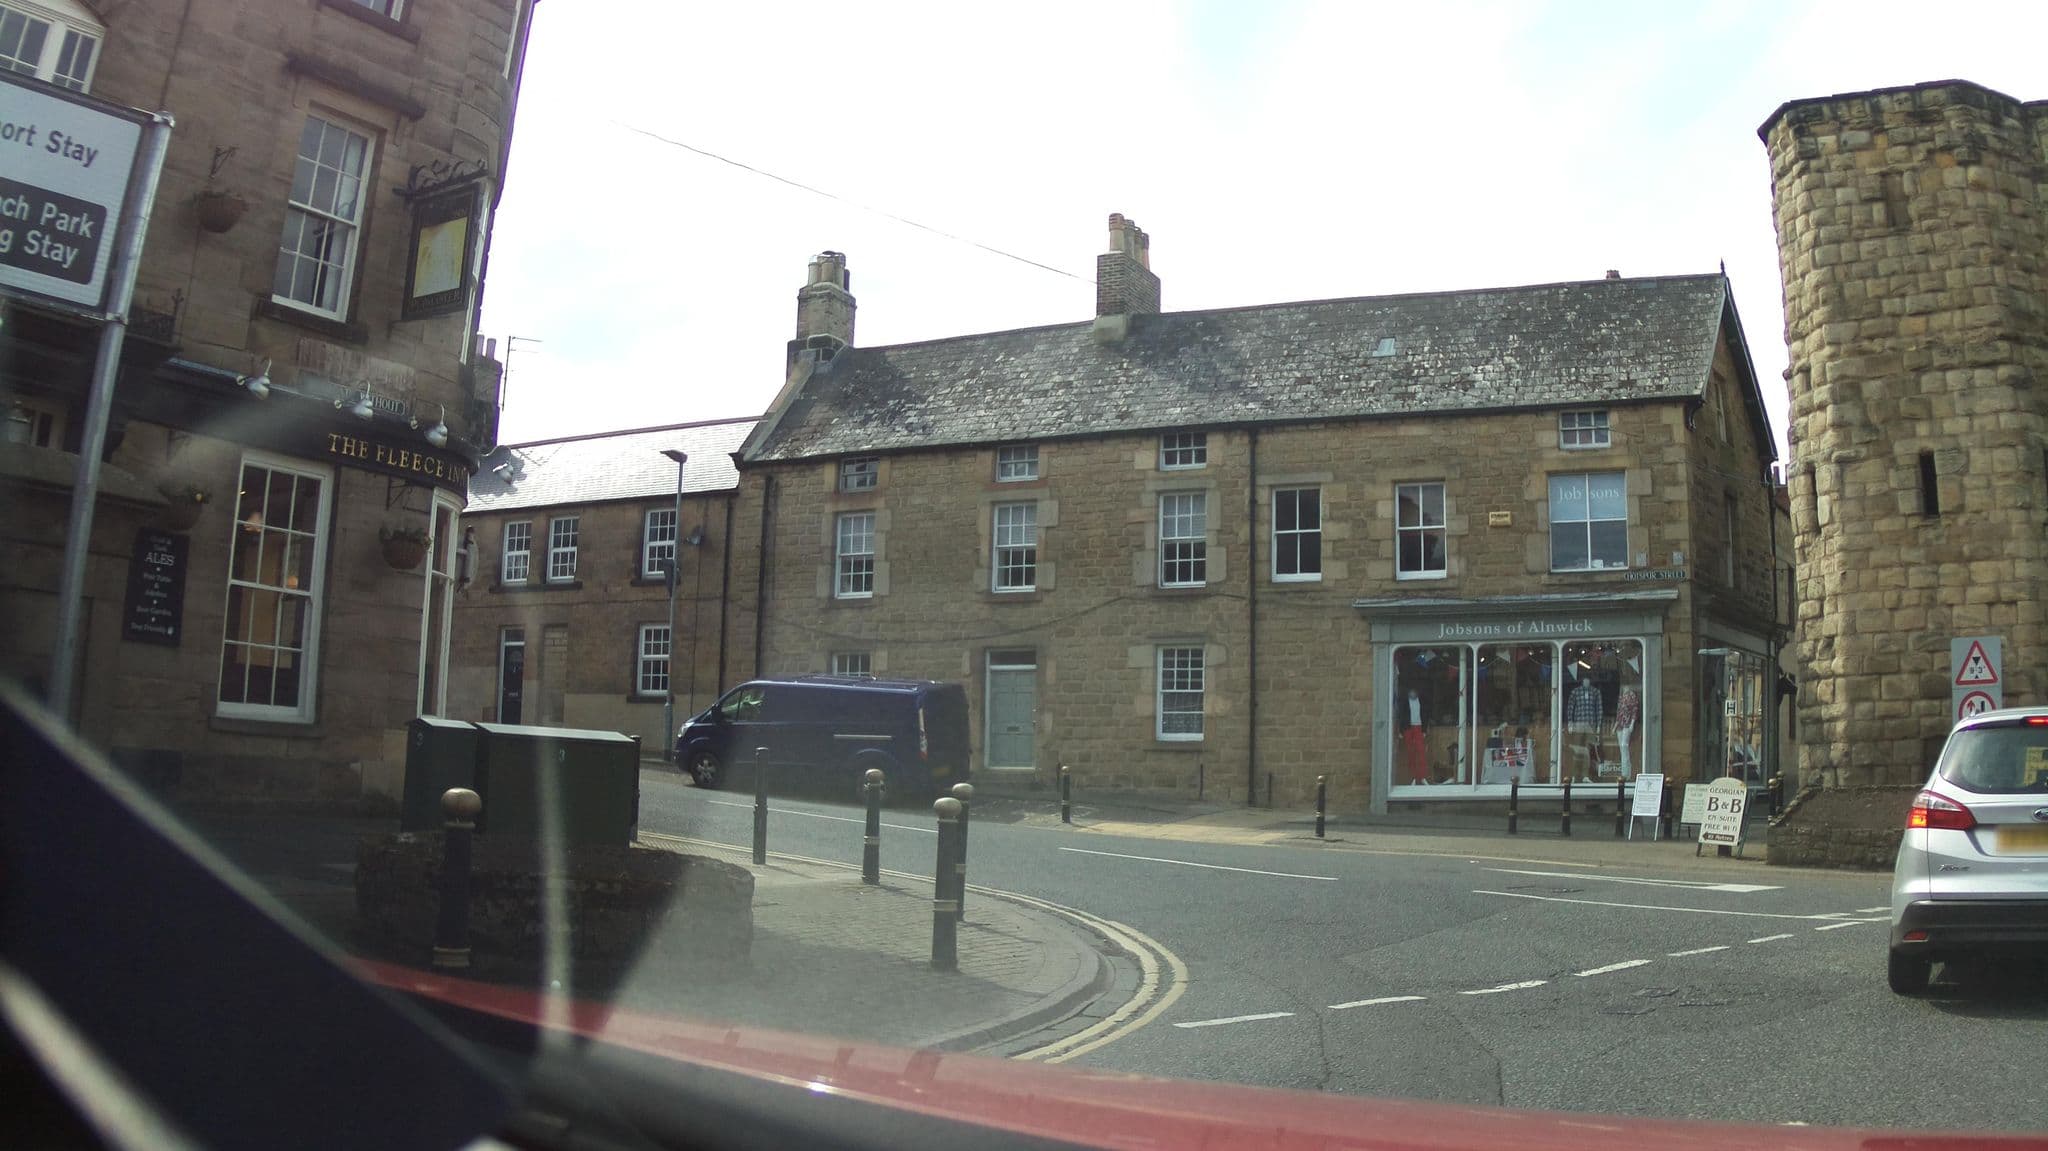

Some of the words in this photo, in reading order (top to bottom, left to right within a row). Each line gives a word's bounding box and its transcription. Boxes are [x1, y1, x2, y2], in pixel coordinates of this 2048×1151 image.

[0, 120, 37, 147] ort
[45, 130, 99, 168] Stay
[40, 202, 96, 239] Park
[23, 229, 79, 269] Stay
[360, 391, 401, 412] WTHOUT
[328, 433, 369, 459] THE
[375, 444, 444, 479] FLEECE
[447, 465, 469, 488] INN
[1558, 485, 1620, 504] Jobsons
[144, 551, 175, 567] ALES
[1438, 622, 1501, 639] Jobsons
[1507, 620, 1524, 634] of
[1528, 619, 1593, 634] Alnwick
[1709, 787, 1745, 796] GEORGIAN
[1707, 796, 1719, 811] B
[1721, 801, 1730, 810] &
[1730, 798, 1742, 813] B
